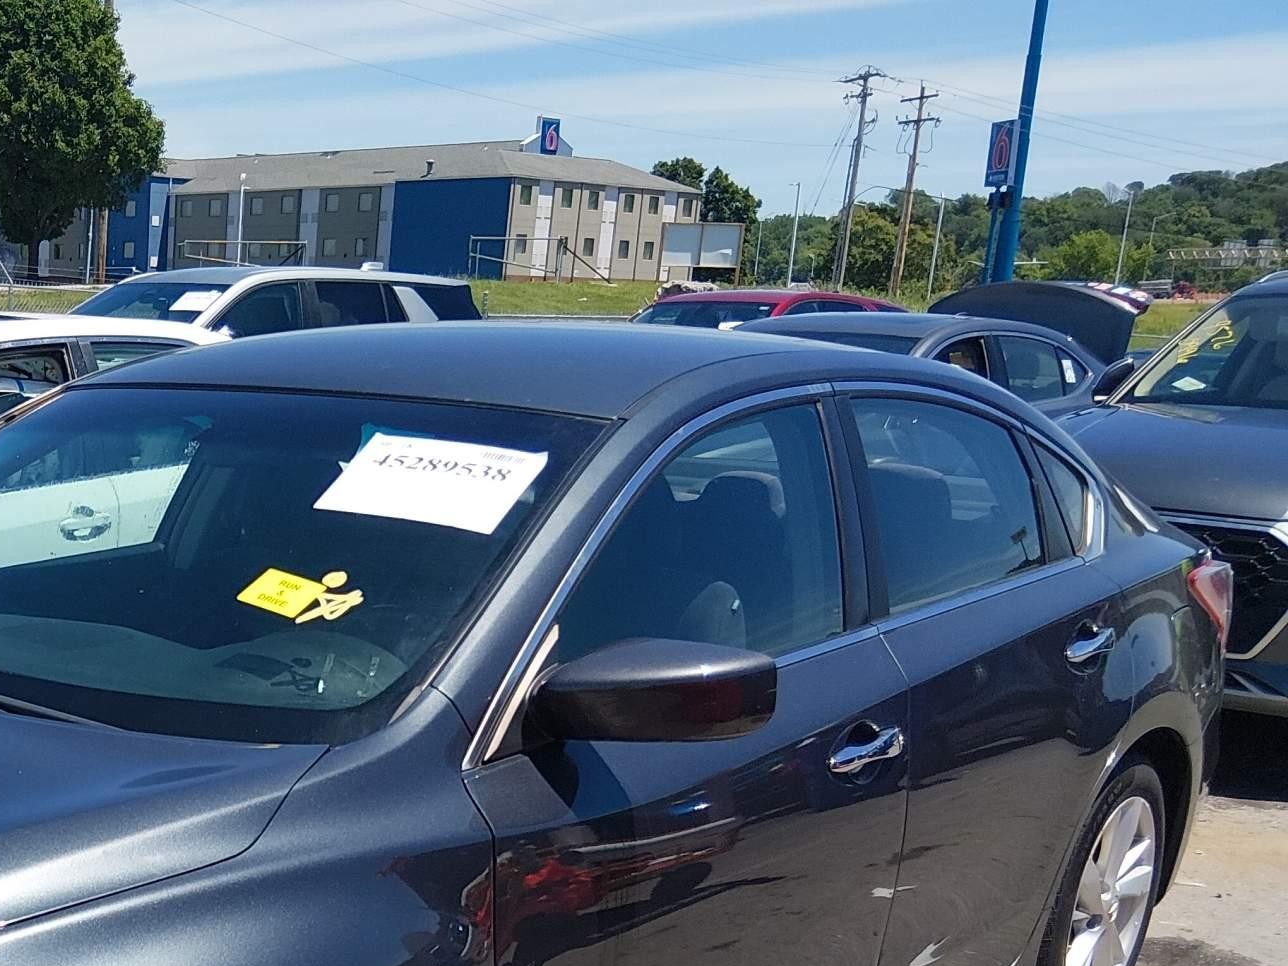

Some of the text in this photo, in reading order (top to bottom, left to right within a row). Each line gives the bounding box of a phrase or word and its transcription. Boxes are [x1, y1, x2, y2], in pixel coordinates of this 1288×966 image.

[545, 124, 558, 151] 6
[992, 125, 1010, 171] 6
[372, 453, 512, 482] 45289538
[278, 579, 303, 591] RUN
[256, 593, 289, 608] DRIVE
